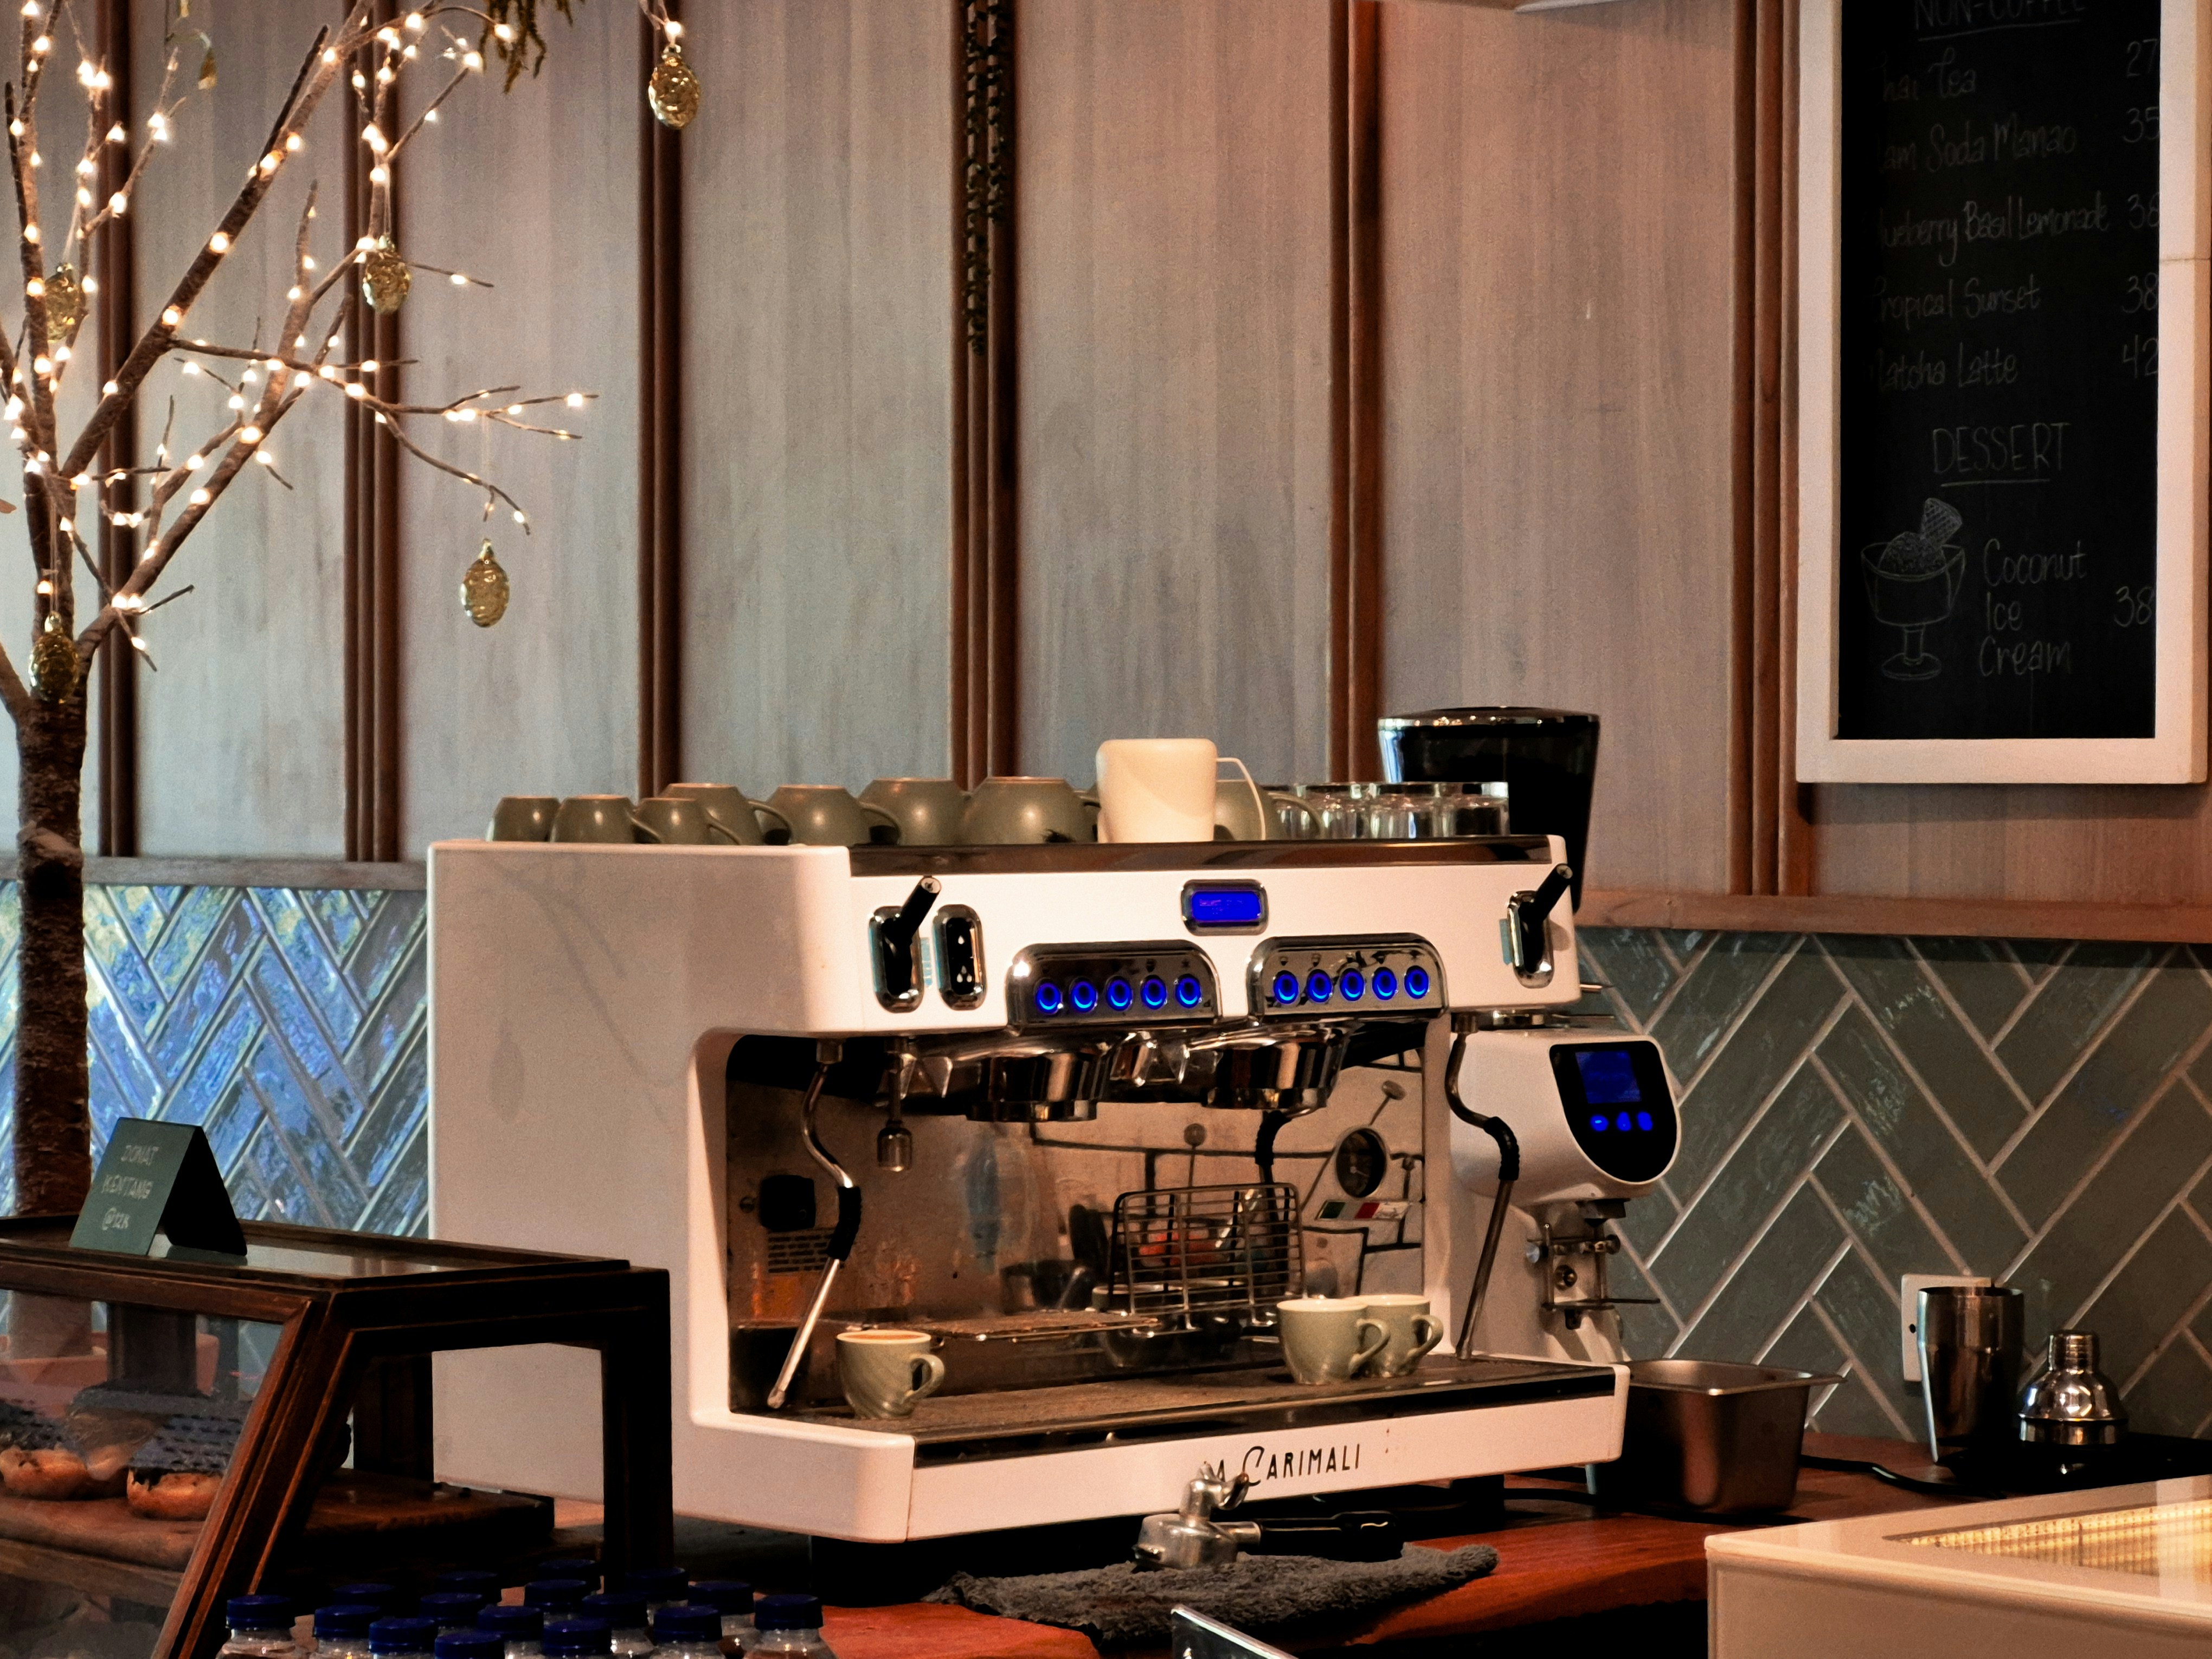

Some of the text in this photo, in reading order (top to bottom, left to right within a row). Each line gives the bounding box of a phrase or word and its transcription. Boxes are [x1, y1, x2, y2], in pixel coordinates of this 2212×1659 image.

[1914, 0, 2086, 31] NON-CO
[1927, 47, 1978, 99] Tea
[2126, 38, 2158, 79] 27
[1925, 120, 1985, 173] Soda
[2122, 106, 2159, 144] 35
[2018, 190, 2110, 241] Lemonade
[1962, 273, 2040, 319] Sunset
[2121, 272, 2158, 314] 38
[1958, 342, 2019, 388] Latte
[2121, 334, 2158, 379] 42
[1932, 422, 2072, 474] DESSERT
[1984, 538, 2087, 587] Coconut
[1986, 585, 2153, 632] Ice 38
[1979, 635, 2072, 677] Cream
[1243, 1443, 1360, 1487] CARIMALI
